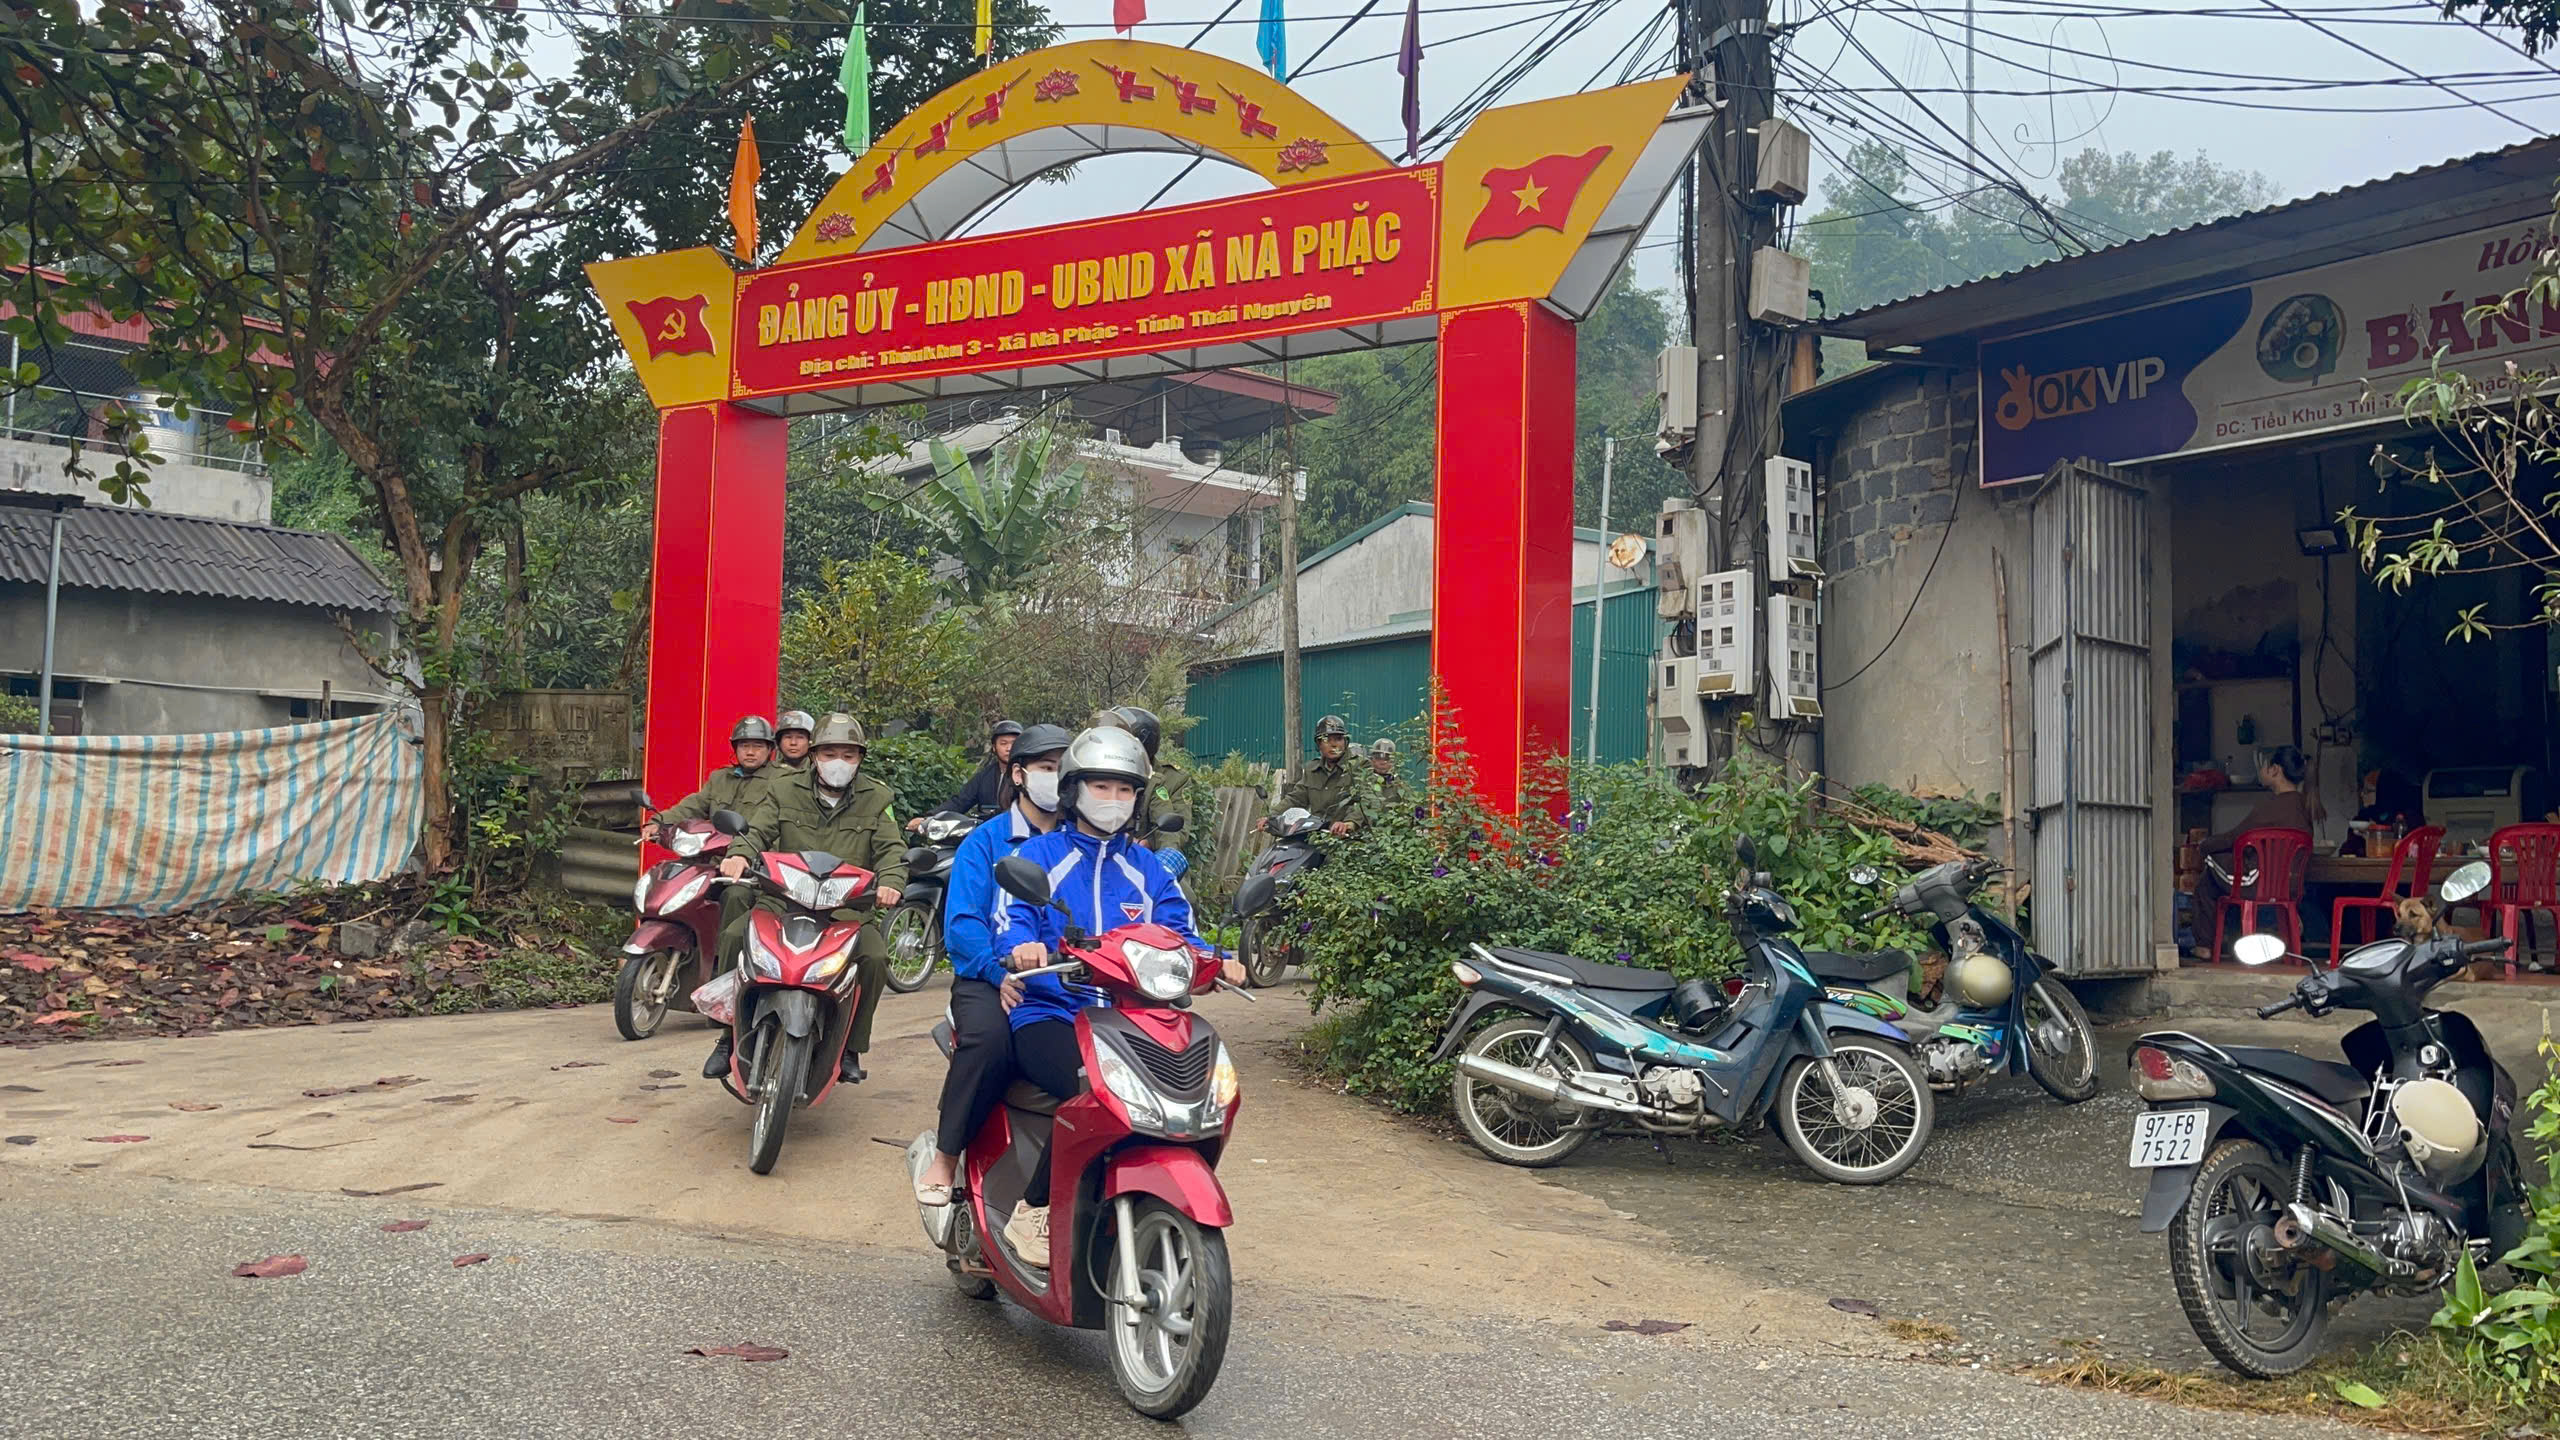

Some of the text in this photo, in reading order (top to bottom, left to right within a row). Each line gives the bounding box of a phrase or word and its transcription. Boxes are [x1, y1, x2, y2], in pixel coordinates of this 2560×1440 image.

[758, 201, 1401, 347] ĐẢNG ỦY - HĐND - UBND XÃ NÀ PHẶC
[800, 358, 833, 378] Địa
[966, 339, 982, 356] 3
[998, 332, 1027, 352] Xã
[1030, 328, 1060, 348] Nà
[1063, 321, 1119, 345] Phặc
[1189, 304, 1238, 328] Thái
[1242, 292, 1332, 321] Nguyên
[2216, 420, 2246, 437] ĐC:
[2292, 407, 2327, 425] Khu
[2333, 403, 2343, 418] 3
[2145, 1114, 2195, 1138] 97-F8
[2141, 1138, 2191, 1163] 7522
